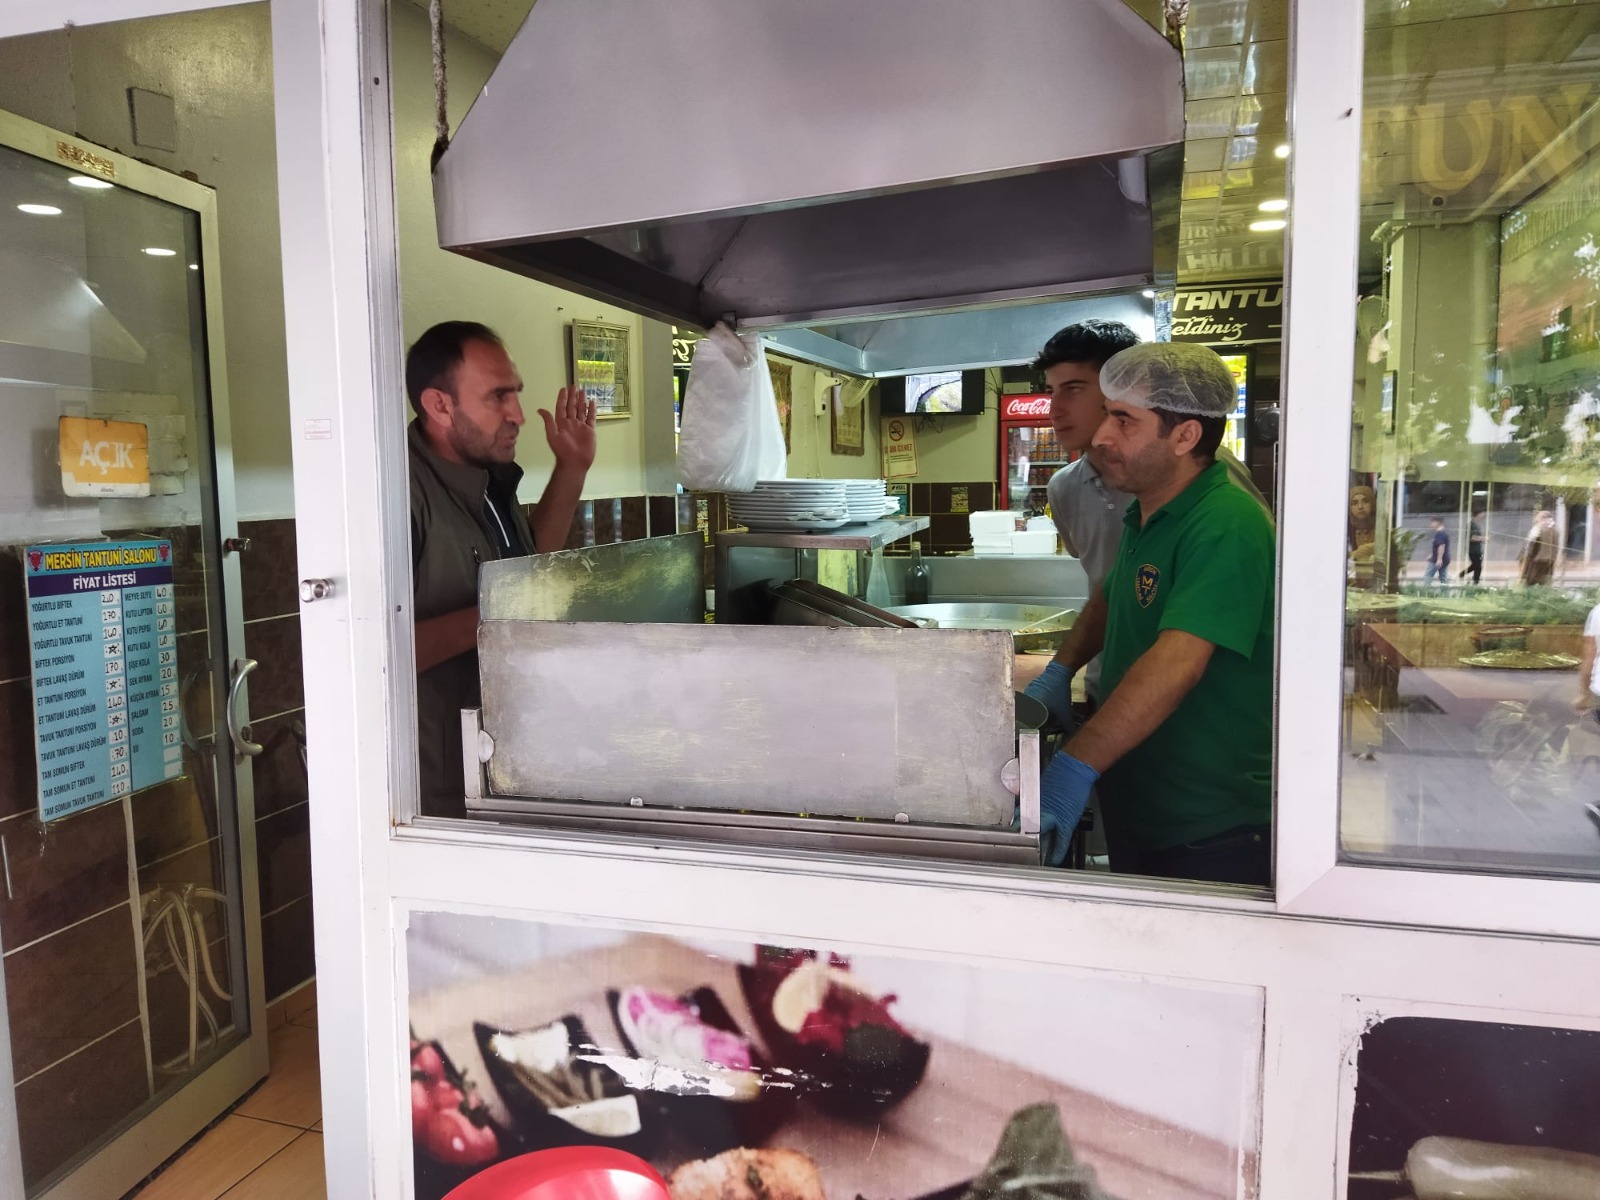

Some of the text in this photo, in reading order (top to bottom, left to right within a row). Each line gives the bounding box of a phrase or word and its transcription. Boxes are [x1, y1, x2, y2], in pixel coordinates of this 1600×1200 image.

[79, 440, 134, 475] AÇIK
[46, 546, 157, 570] MERSİN TANTUNİ SALONU
[73, 571, 136, 590] FİYAT LİSTESİ
[103, 610, 116, 621] 170
[58, 619, 64, 628] ET
[160, 652, 170, 663] 30
[106, 662, 119, 673] 170
[161, 668, 172, 678] 20
[161, 685, 170, 696] 15
[37, 696, 43, 706] ET
[163, 701, 173, 711] 25
[39, 716, 44, 725] ET
[164, 717, 172, 727] 20
[165, 734, 174, 743] 10
